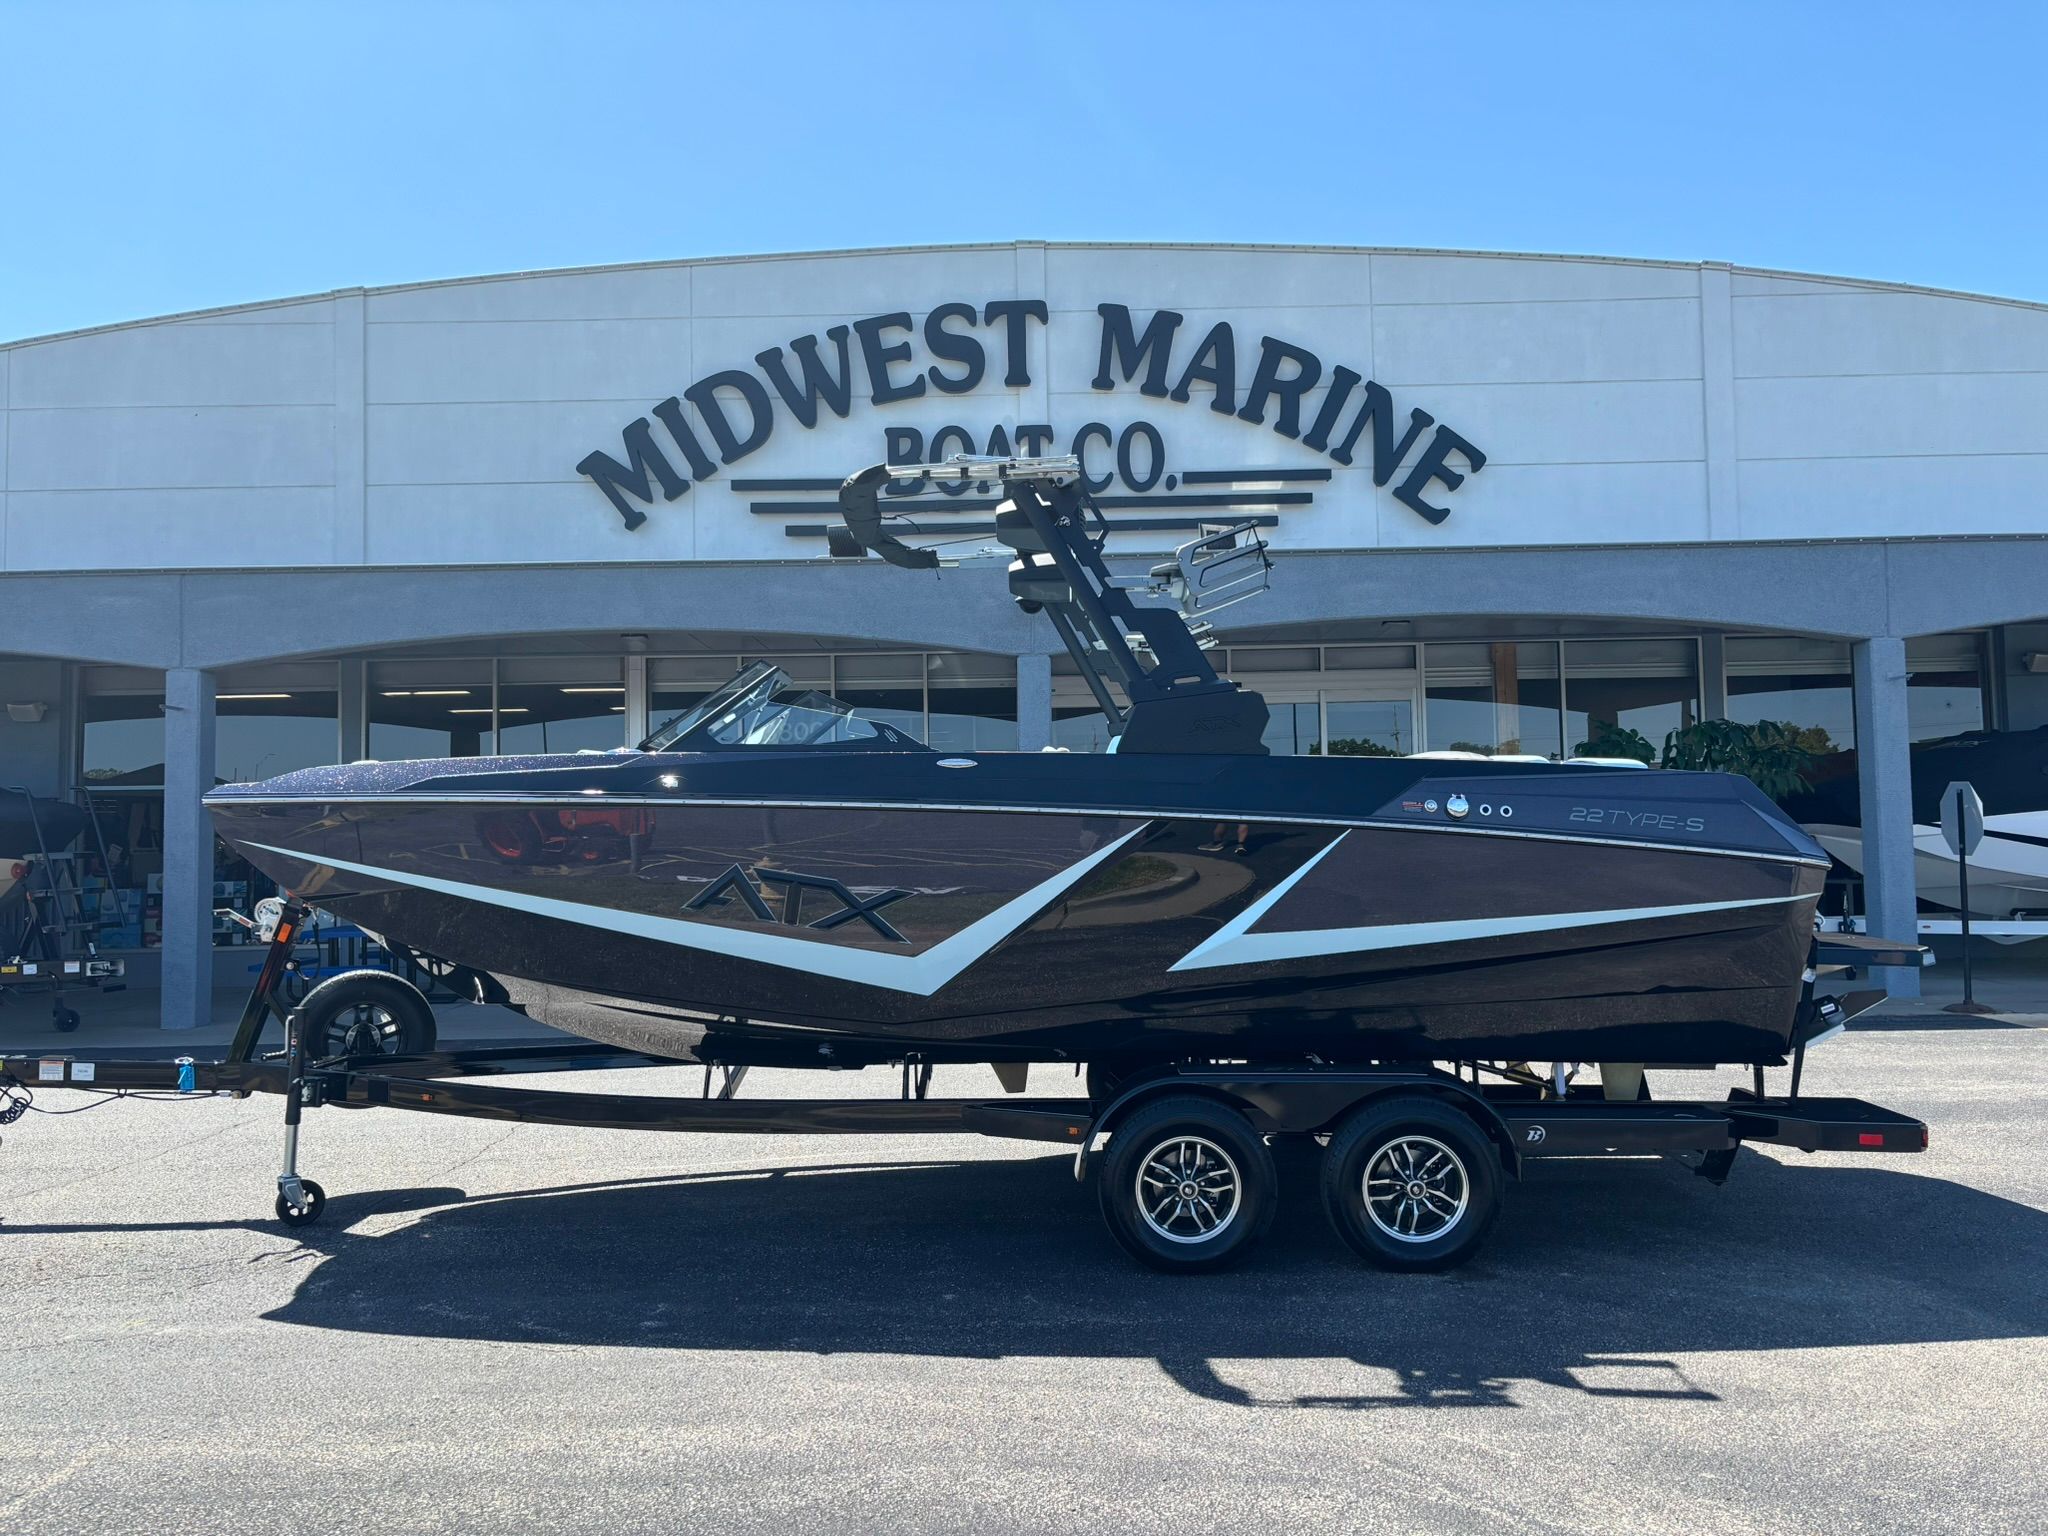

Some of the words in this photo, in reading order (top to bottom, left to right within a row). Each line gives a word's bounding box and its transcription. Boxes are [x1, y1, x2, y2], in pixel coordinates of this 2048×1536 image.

[576, 300, 1049, 531] MIDWEST
[1091, 303, 1487, 525] MARINE
[1072, 421, 1177, 494] CO.
[1569, 807, 1604, 823] 22
[1608, 809, 1705, 832] TYPE-S
[680, 862, 919, 944] ATX
